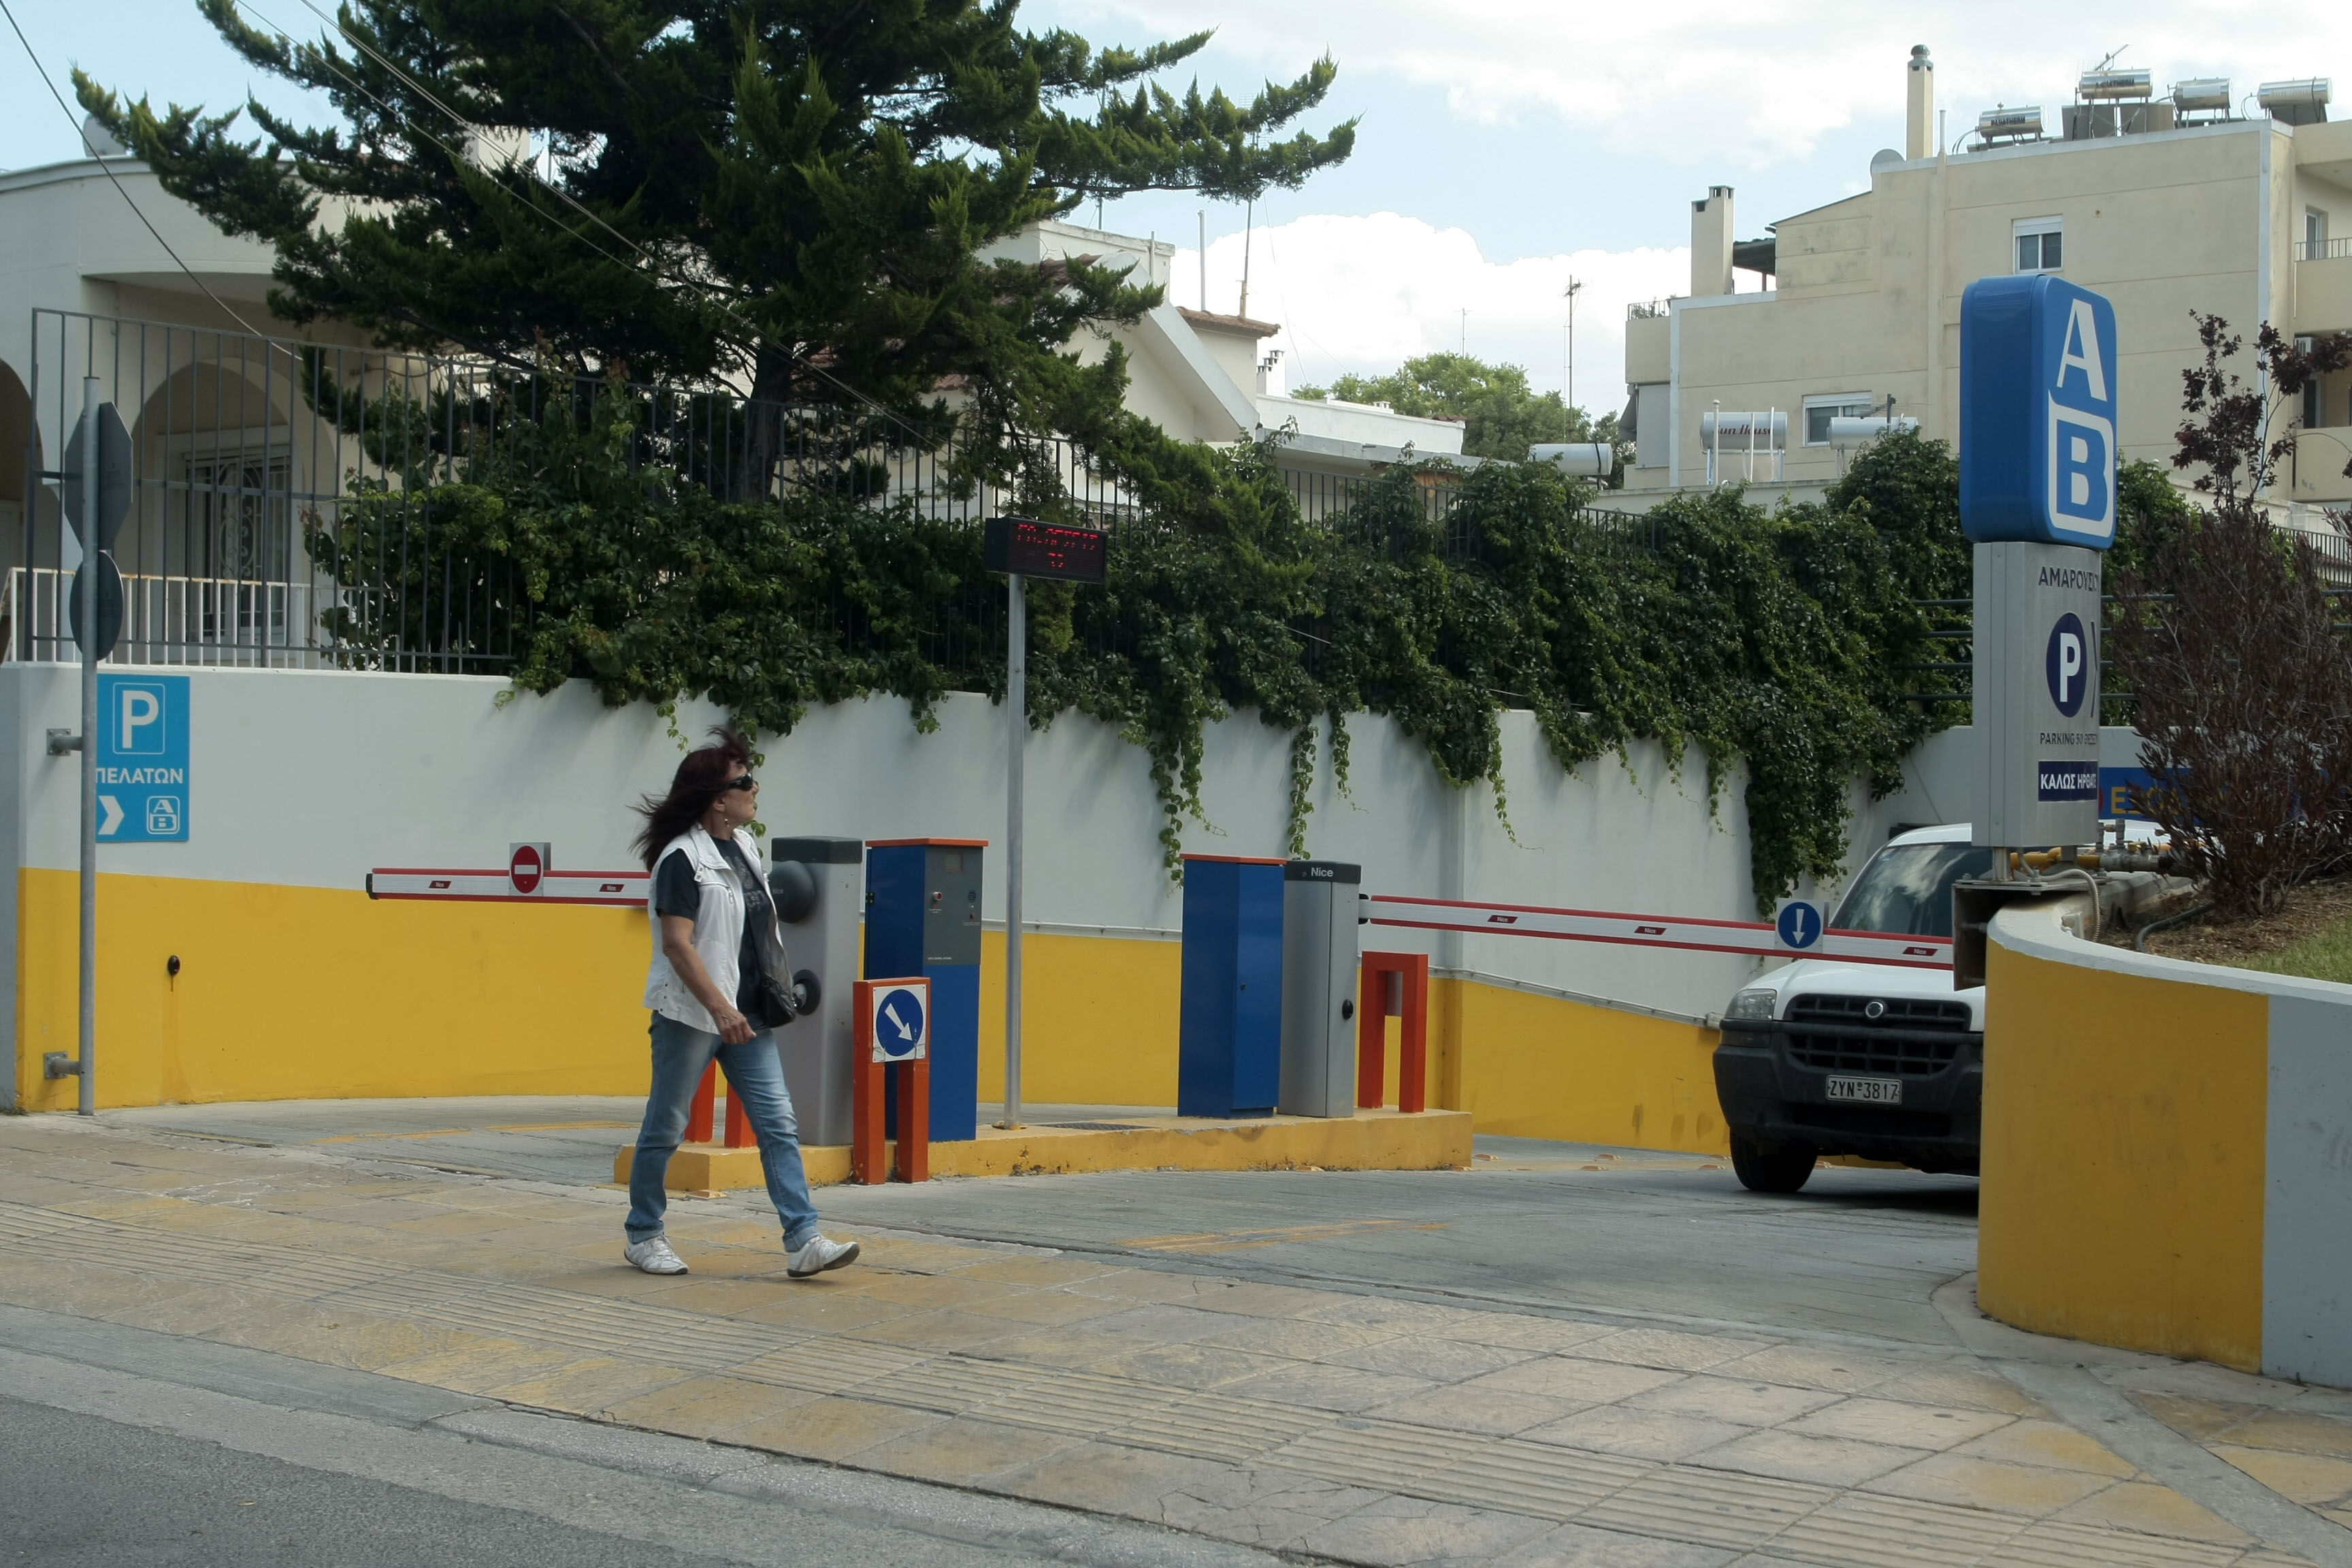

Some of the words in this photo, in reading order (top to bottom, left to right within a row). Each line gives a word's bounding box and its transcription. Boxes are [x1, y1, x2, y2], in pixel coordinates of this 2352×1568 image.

[2059, 632, 2081, 702] P
[122, 689, 159, 749] P
[2040, 732, 2075, 745] PARKING
[96, 767, 183, 785] ΠΕΛΑΤΩΝ
[2041, 773, 2076, 789] ΚΑΛΩΣ
[1311, 867, 1334, 877] Nice
